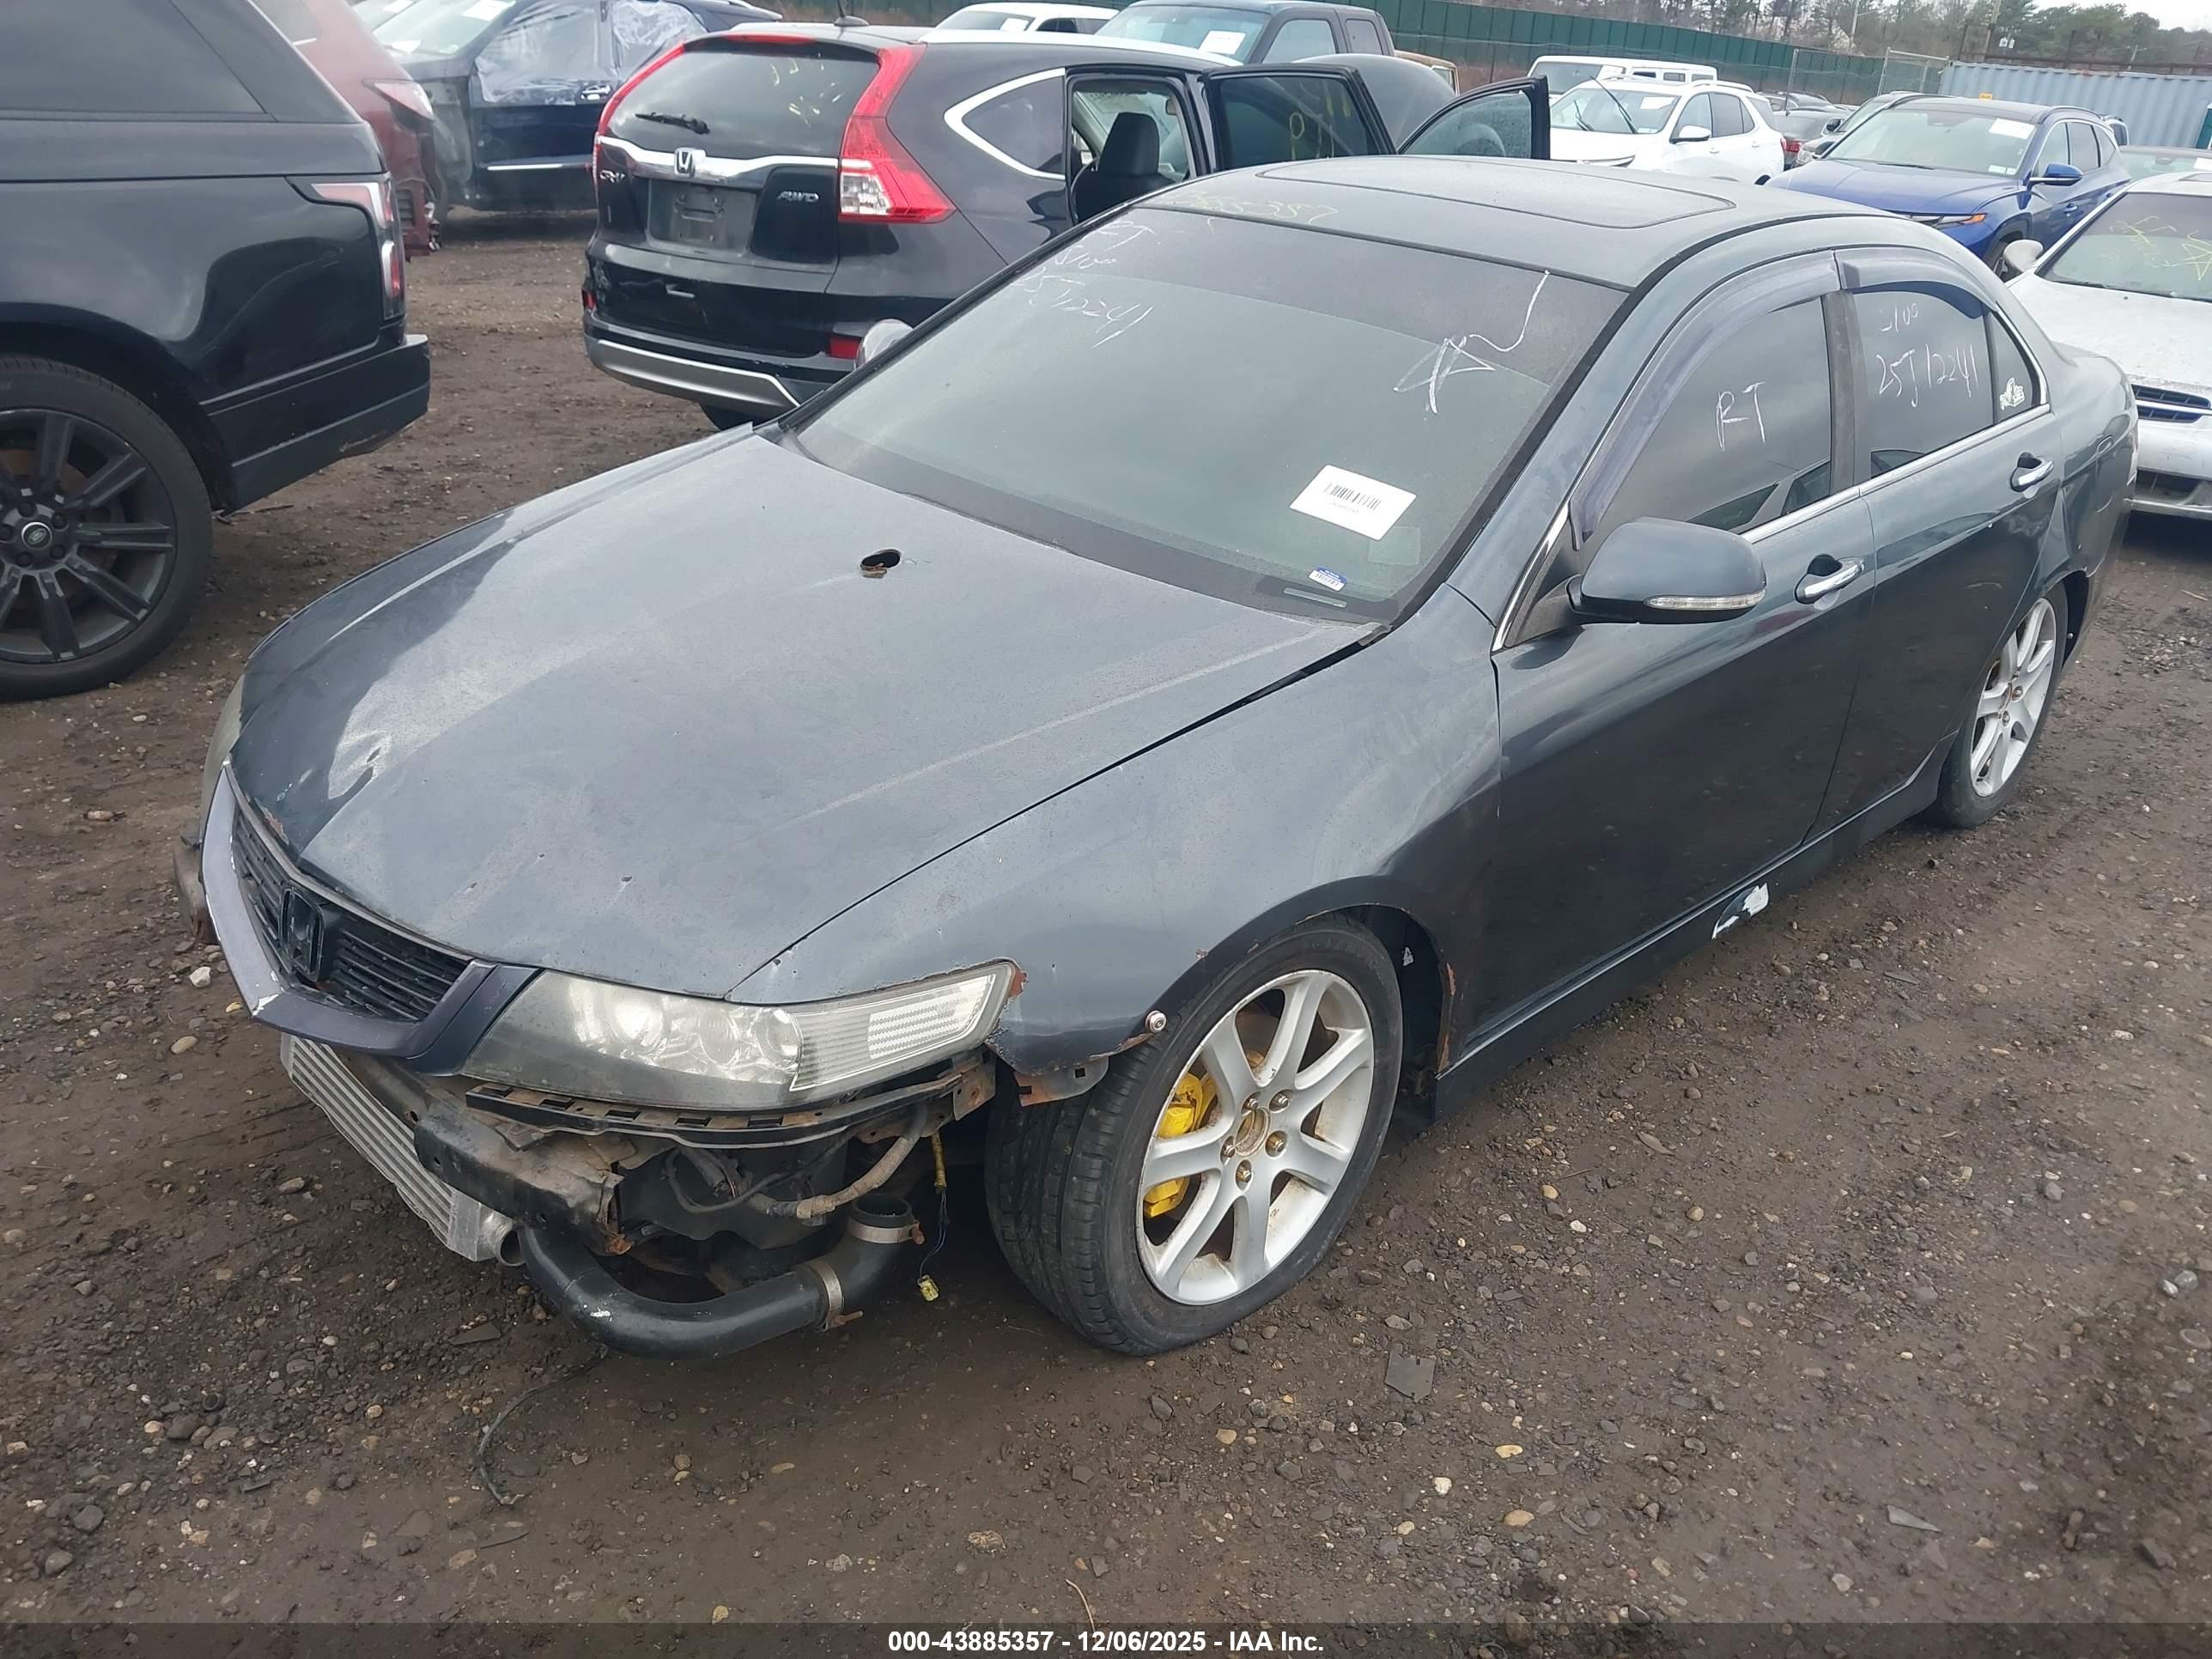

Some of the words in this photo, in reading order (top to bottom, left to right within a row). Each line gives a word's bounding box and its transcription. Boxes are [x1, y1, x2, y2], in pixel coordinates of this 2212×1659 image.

[776, 190, 820, 204] AWD
[1875, 343, 1979, 408] 25J12241
[1716, 380, 1766, 452] RT
